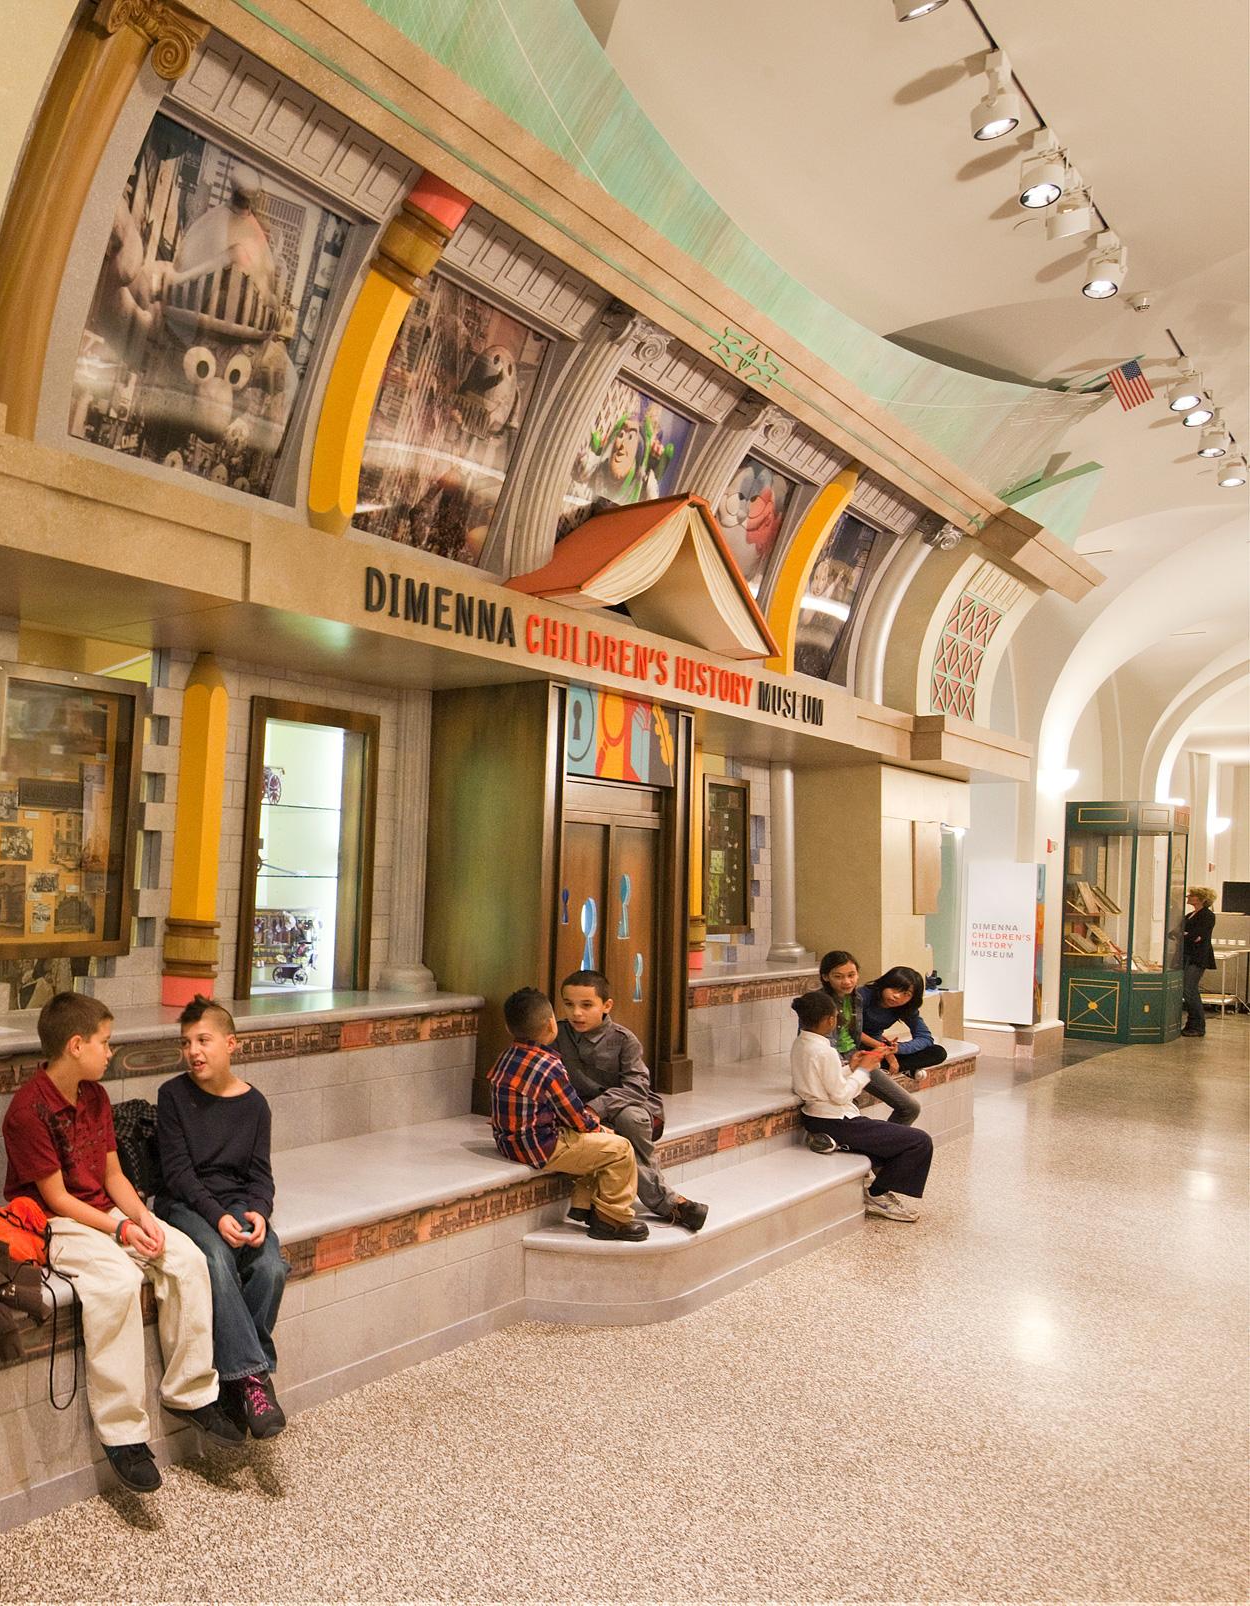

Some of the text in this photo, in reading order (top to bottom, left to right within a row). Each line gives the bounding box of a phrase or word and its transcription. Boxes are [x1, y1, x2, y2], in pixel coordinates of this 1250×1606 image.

[365, 566, 824, 727] DIMENNA CHILDREN'S HISTORY MUSEUM
[972, 923, 1018, 931] DIMENNA
[972, 932, 1031, 941] CHILDREN'S
[971, 941, 1014, 949] HISTORY
[971, 950, 1014, 959] MUSEUM
